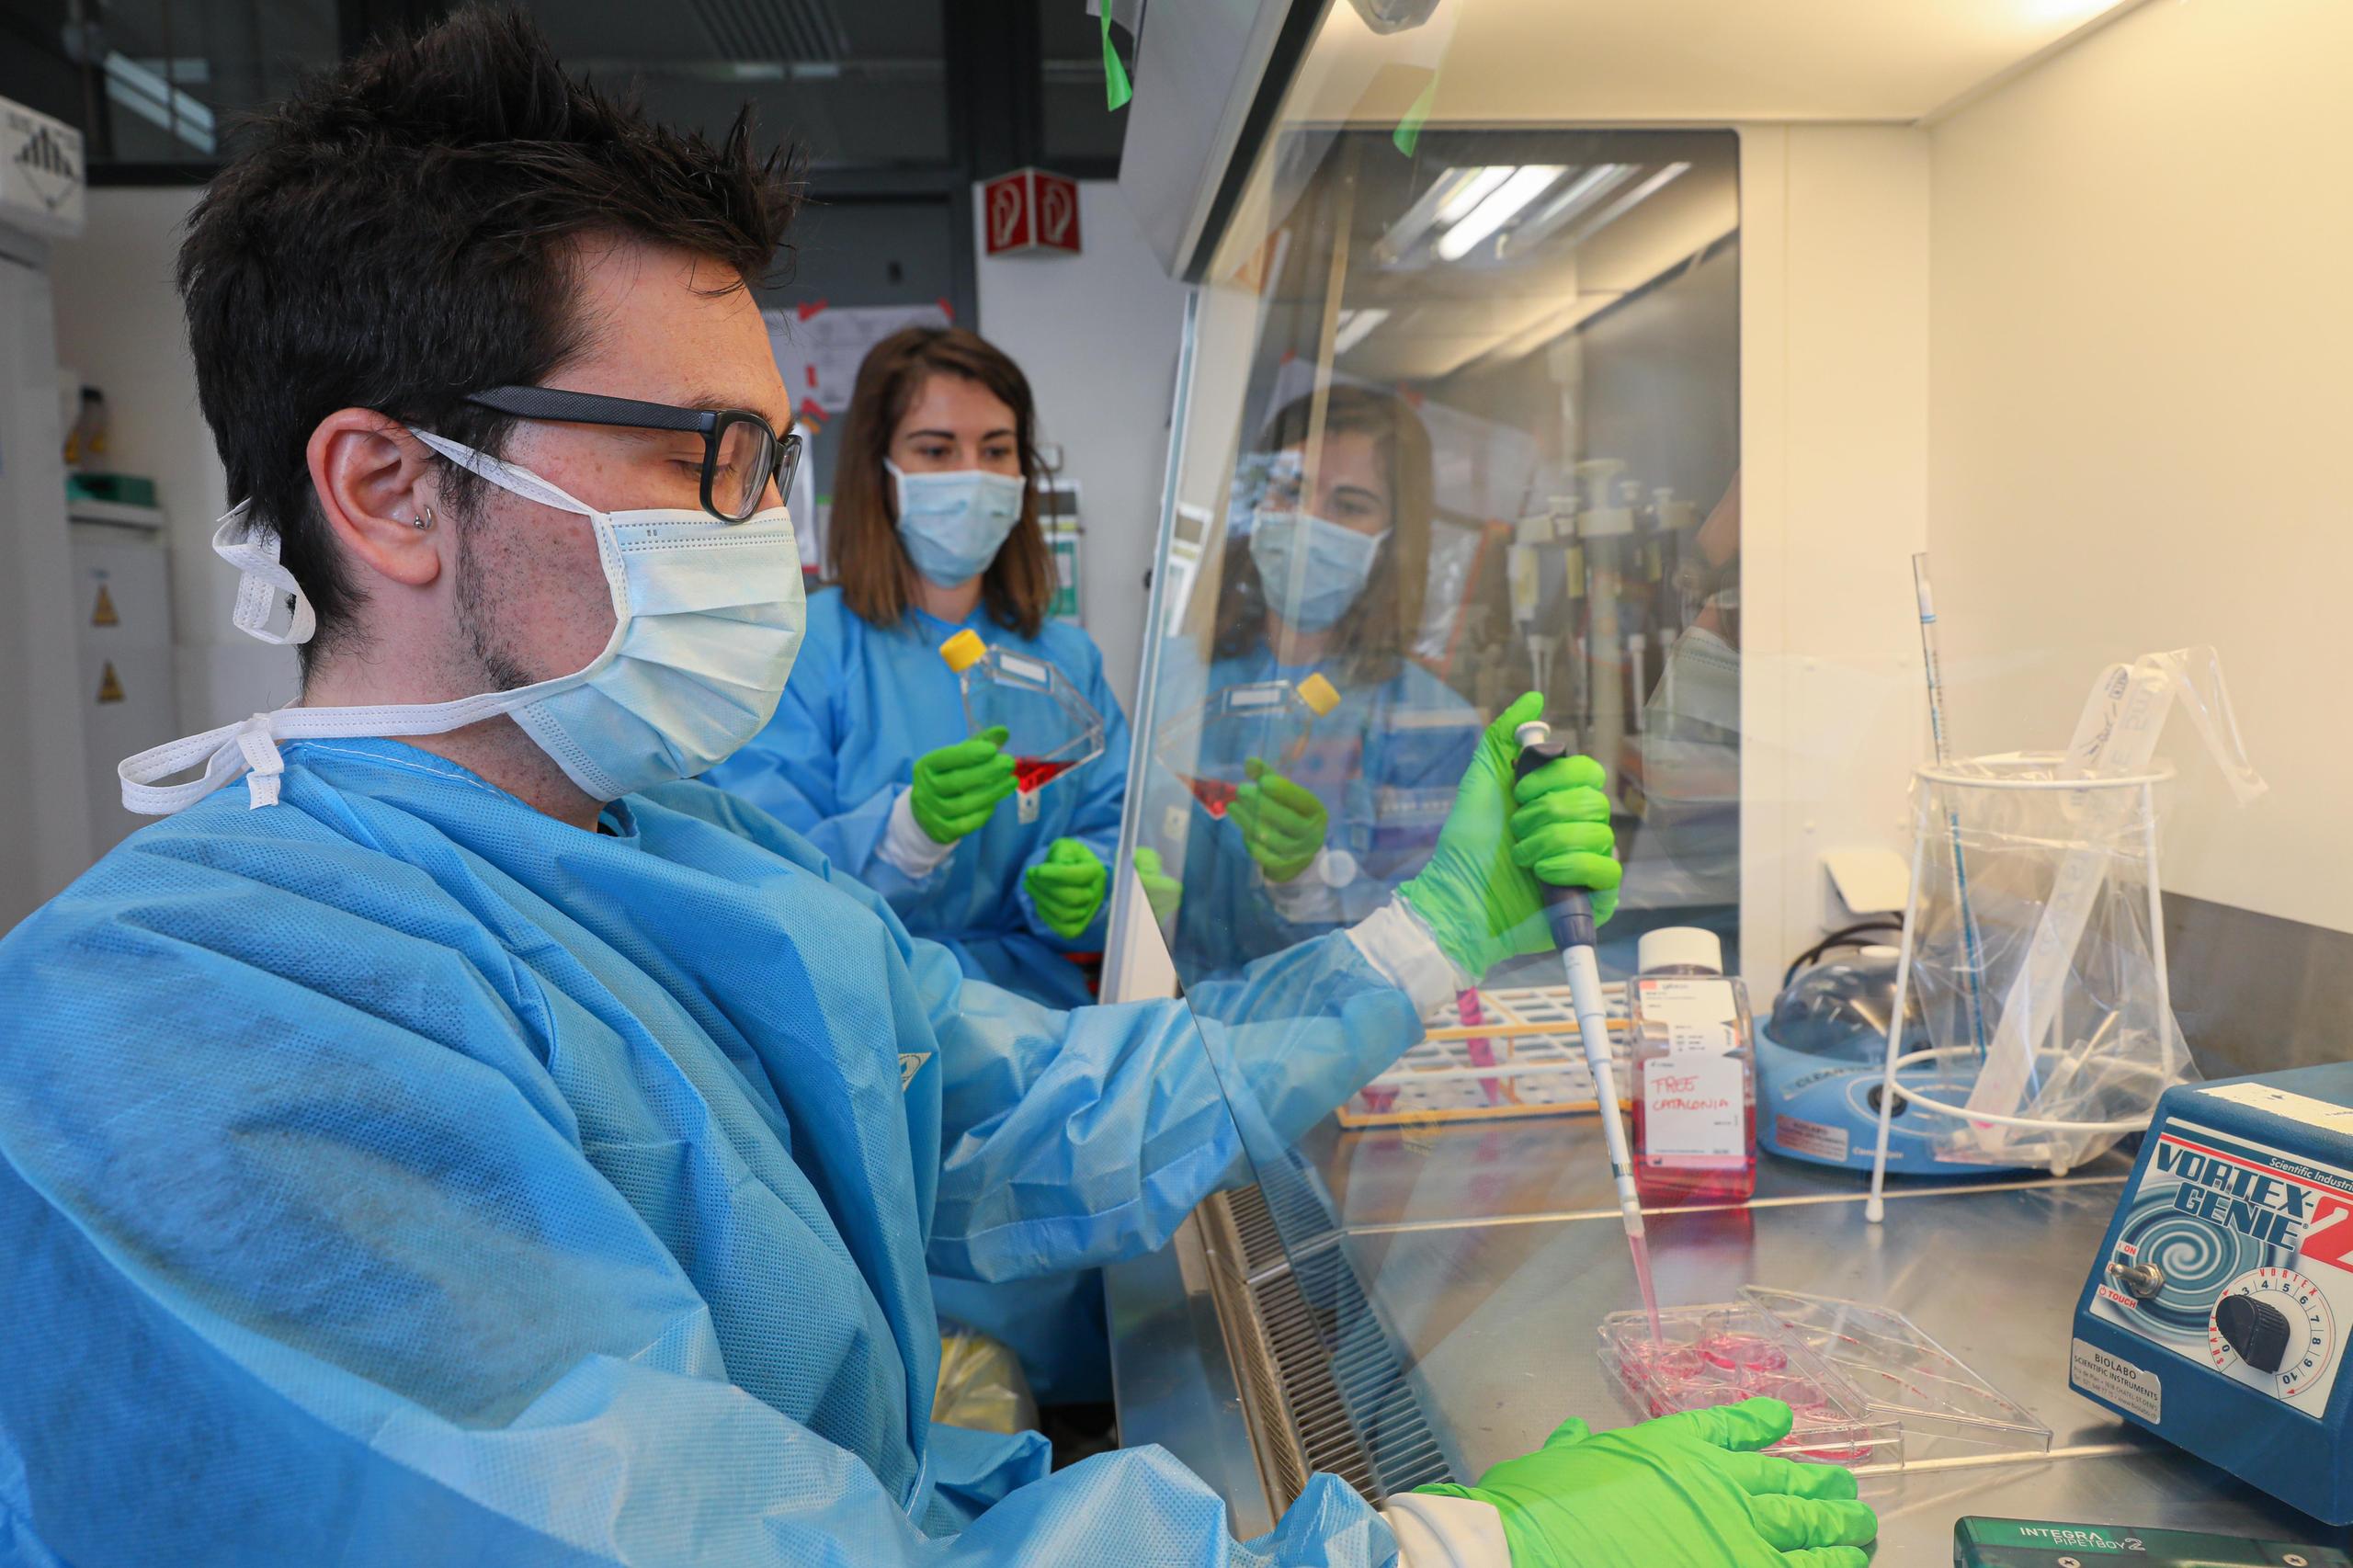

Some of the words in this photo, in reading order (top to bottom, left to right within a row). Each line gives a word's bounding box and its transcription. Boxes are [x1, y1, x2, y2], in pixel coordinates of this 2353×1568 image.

[2268, 1157, 2313, 1180] Scientific
[2300, 1195, 2353, 1274] 2
[2124, 1244, 2137, 1256] ON
[2259, 1268, 2317, 1296] VORTEX
[2261, 1279, 2269, 1289] 4
[2282, 1283, 2290, 1293] 5
[2242, 1287, 2250, 1296] 3
[2109, 1290, 2137, 1309] TOUCH
[2299, 1295, 2309, 1305] 6
[2311, 1314, 2320, 1324] 7
[2312, 1336, 2322, 1346] 8
[2095, 1353, 2137, 1380] BIOLABO
[2303, 1358, 2313, 1368] 9
[2074, 1356, 2109, 1377] SCIENTIFIC
[2109, 1372, 2158, 1401] INSTRUMENTS
[2282, 1372, 2298, 1384] 10
[2019, 1527, 2103, 1541] INTEGRA
[2053, 1537, 2125, 1550] PIPETBOY
[2124, 1537, 2146, 1551] 2
